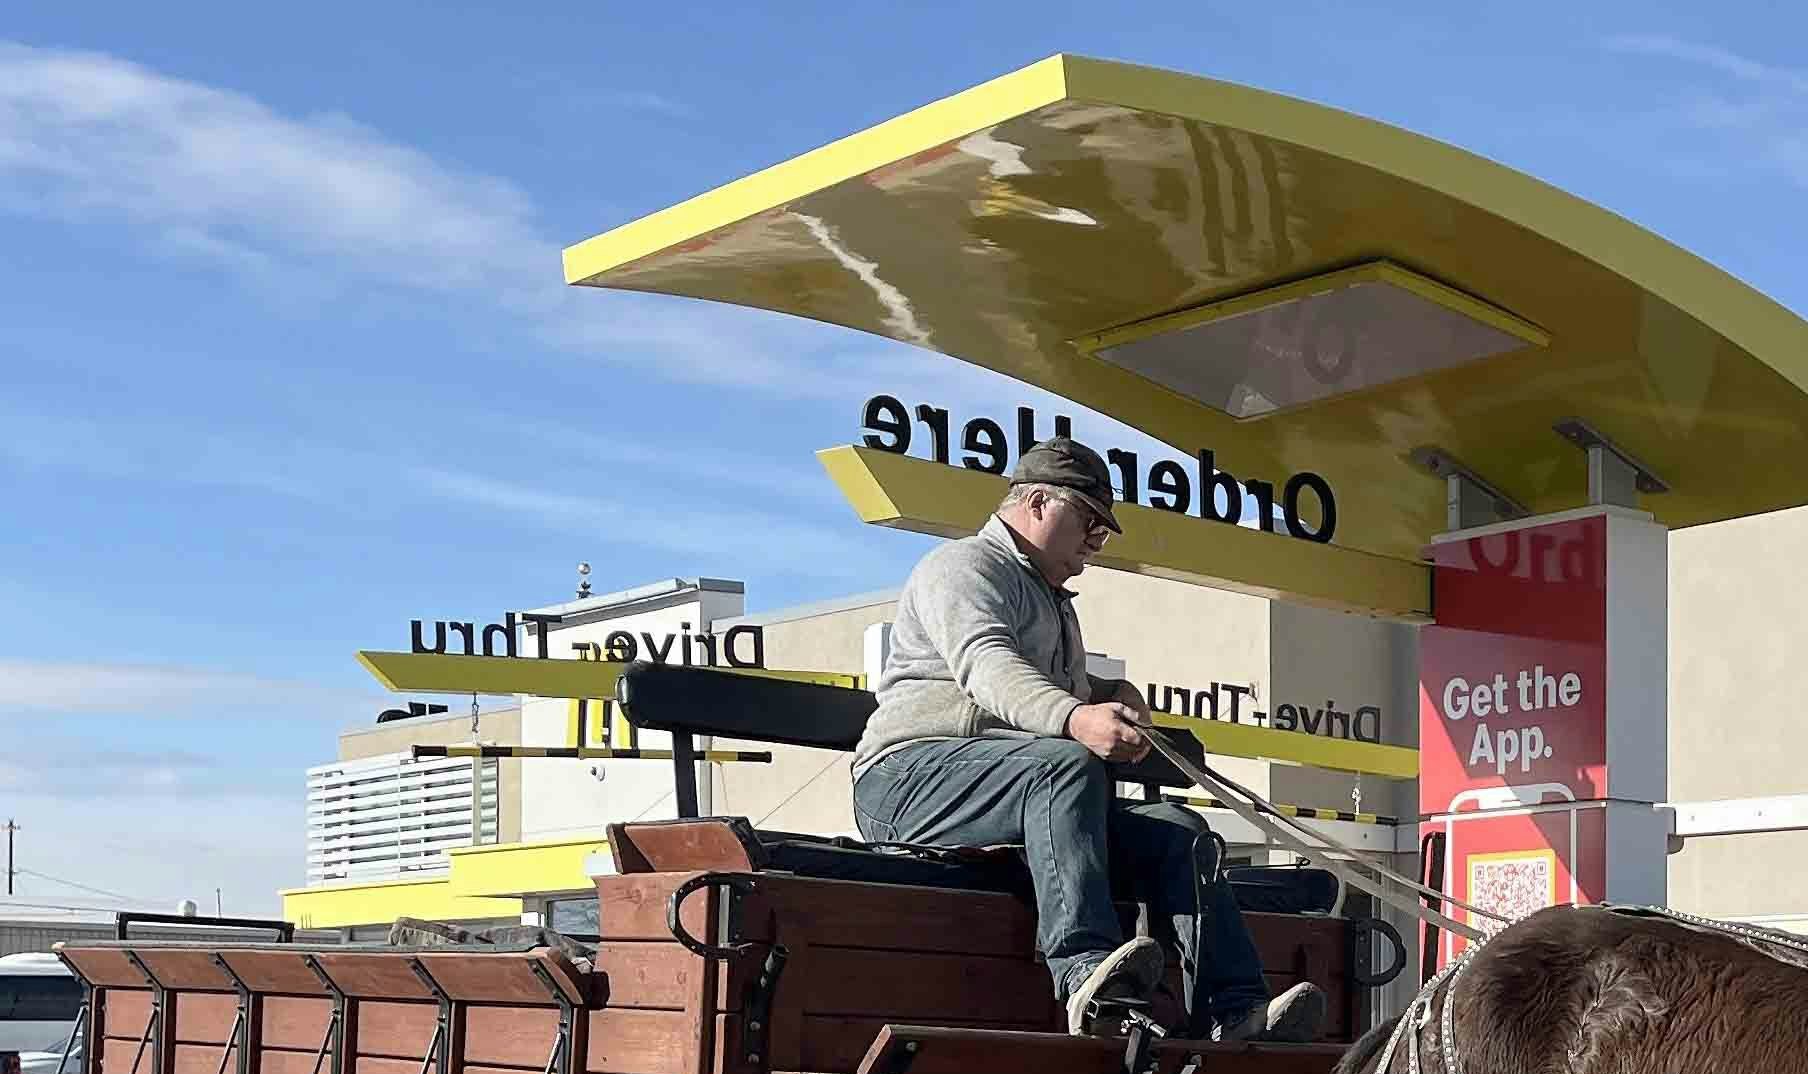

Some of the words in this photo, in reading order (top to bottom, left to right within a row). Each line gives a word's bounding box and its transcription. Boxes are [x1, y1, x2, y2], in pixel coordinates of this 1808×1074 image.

[1442, 673, 1510, 720] Get
[1516, 664, 1582, 709] the
[1469, 722, 1552, 774] App.
